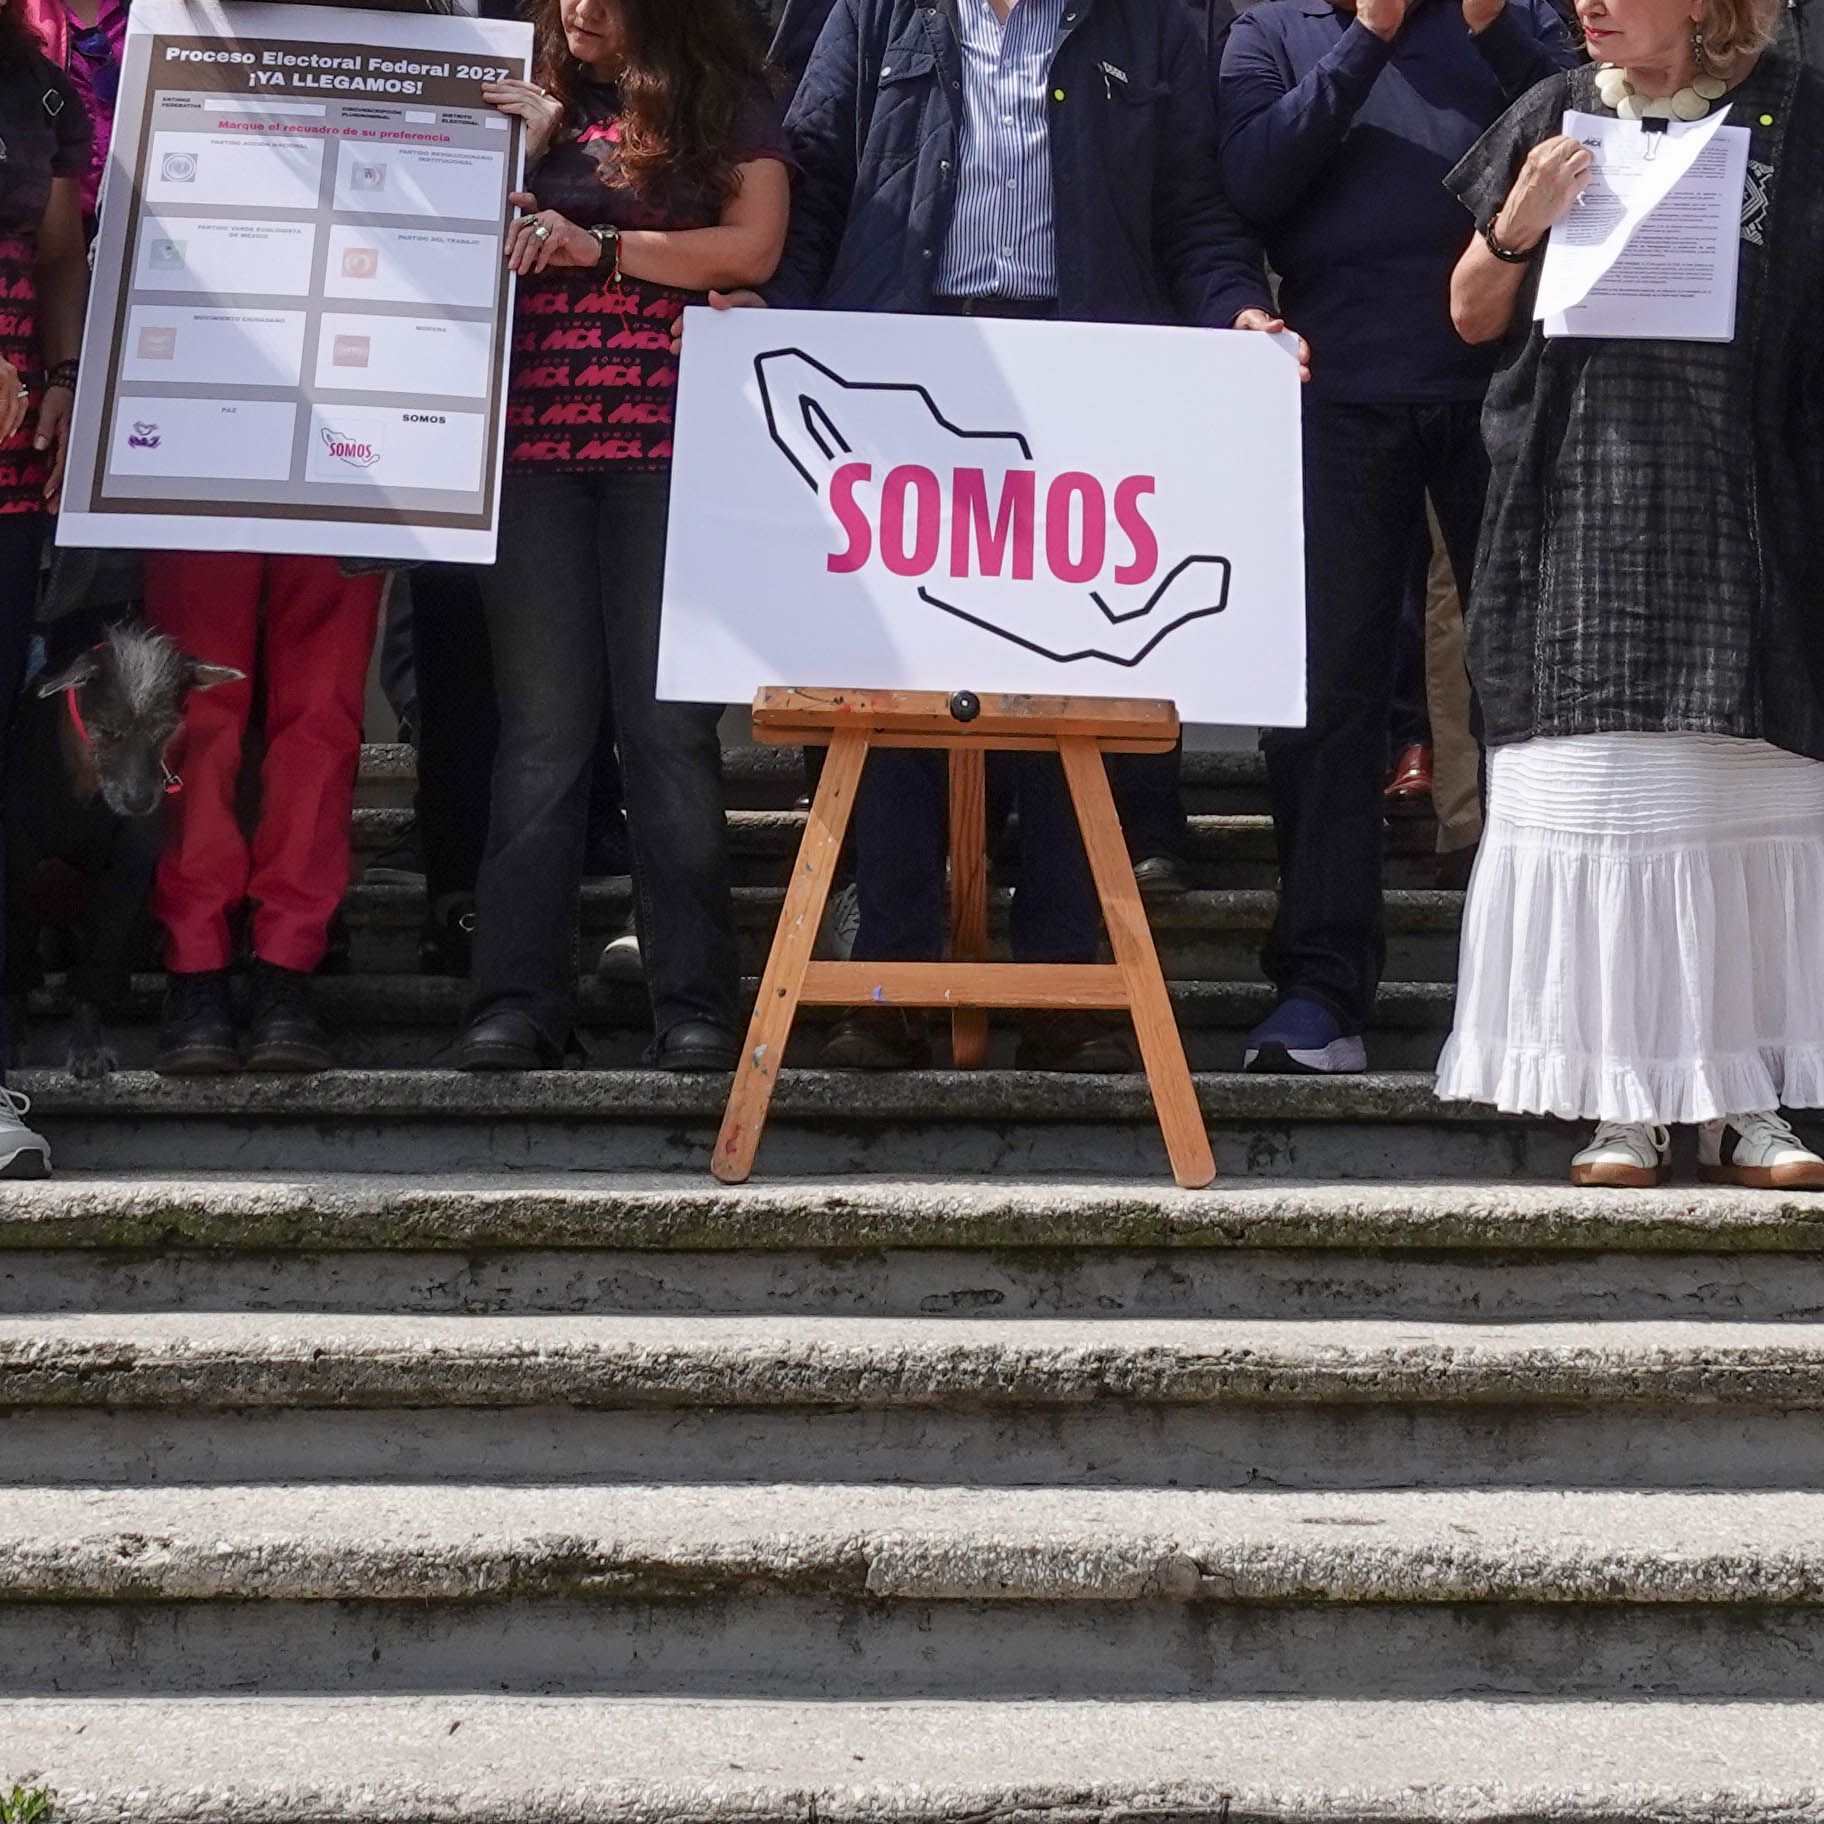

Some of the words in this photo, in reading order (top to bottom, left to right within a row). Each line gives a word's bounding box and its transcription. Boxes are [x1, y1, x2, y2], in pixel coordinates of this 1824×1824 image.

[166, 47, 256, 66] Proceso
[262, 51, 361, 72] Electoral
[369, 57, 450, 78] Federal
[457, 65, 510, 83] 2027
[248, 71, 286, 87] ¡YA
[292, 72, 424, 95] LLEGAMOS!
[218, 120, 265, 135] Marque
[268, 122, 280, 131] el
[283, 124, 339, 136] recuadro
[343, 126, 358, 137] de
[361, 129, 377, 139] su
[380, 130, 451, 144] preferencia
[402, 413, 447, 425] SOMOS
[329, 442, 373, 460] SOMOS
[826, 461, 1160, 585] SOMOS
